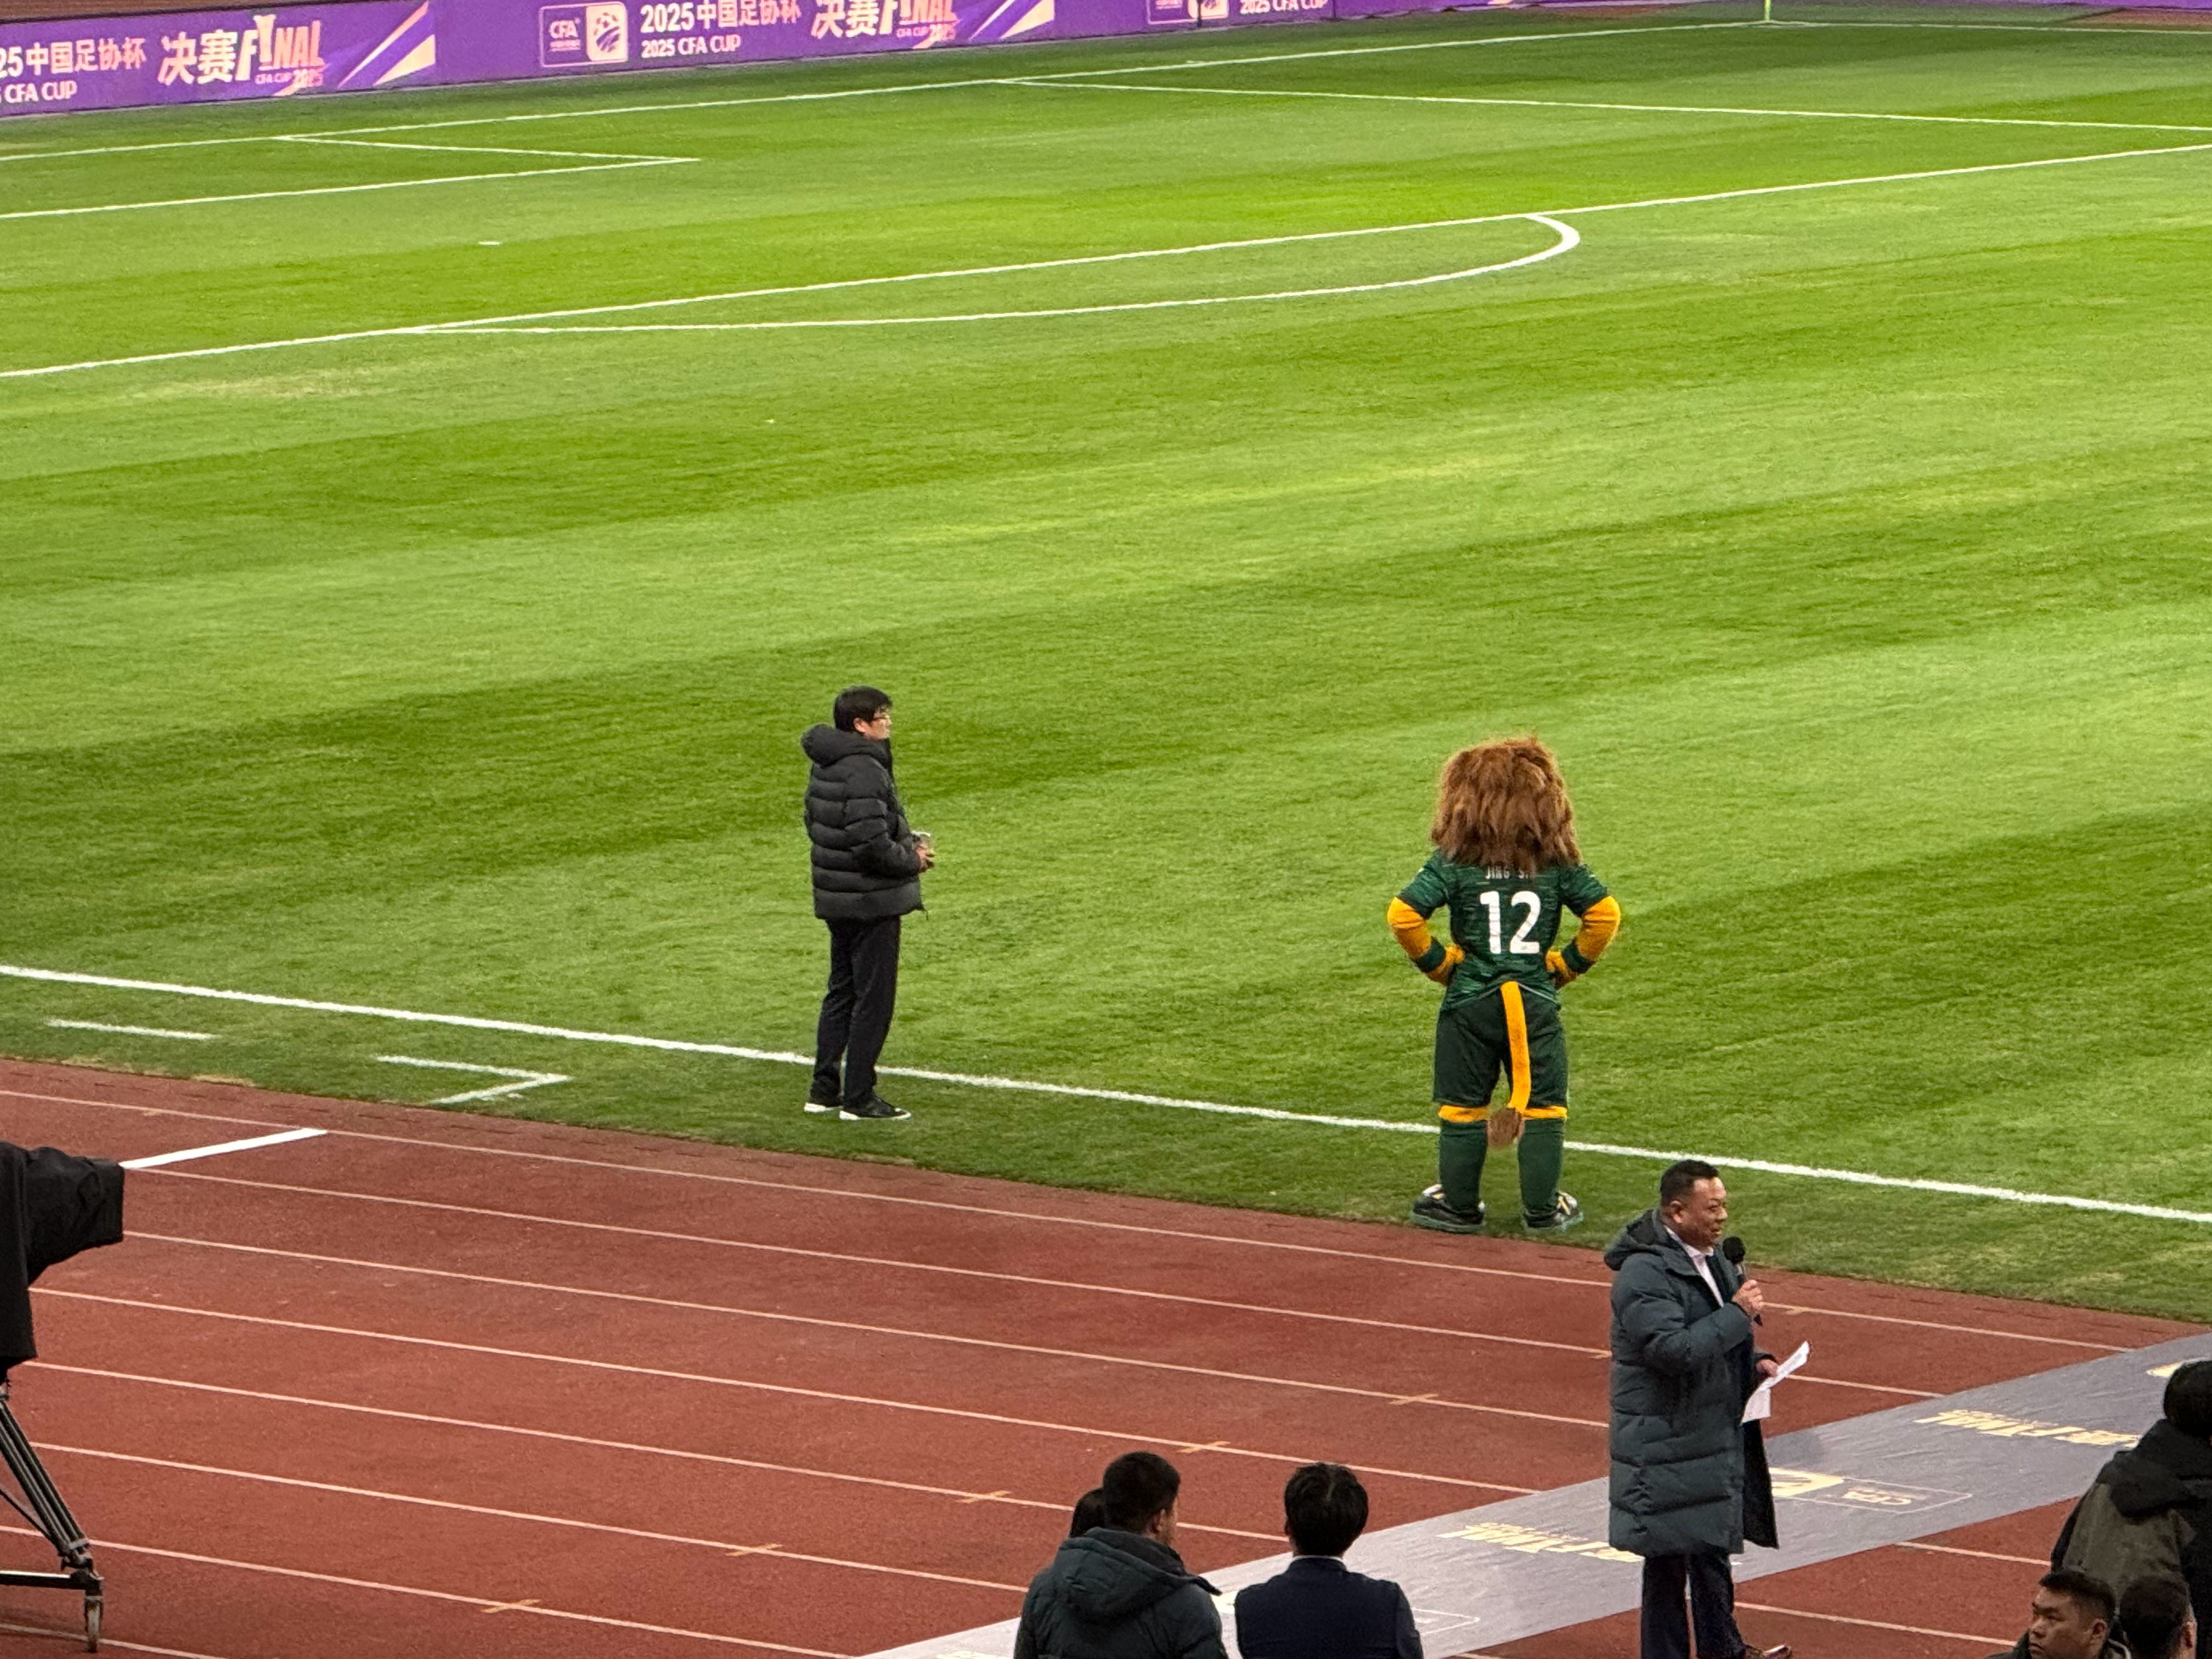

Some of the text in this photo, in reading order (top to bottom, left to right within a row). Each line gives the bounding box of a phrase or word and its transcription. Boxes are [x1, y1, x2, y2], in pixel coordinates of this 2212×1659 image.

[157, 29, 238, 86] 决赛
[641, 34, 741, 58] 2025 CFA CUP
[4, 83, 39, 103] CFA
[41, 80, 77, 100] CUP
[1480, 890, 1542, 955] 12
